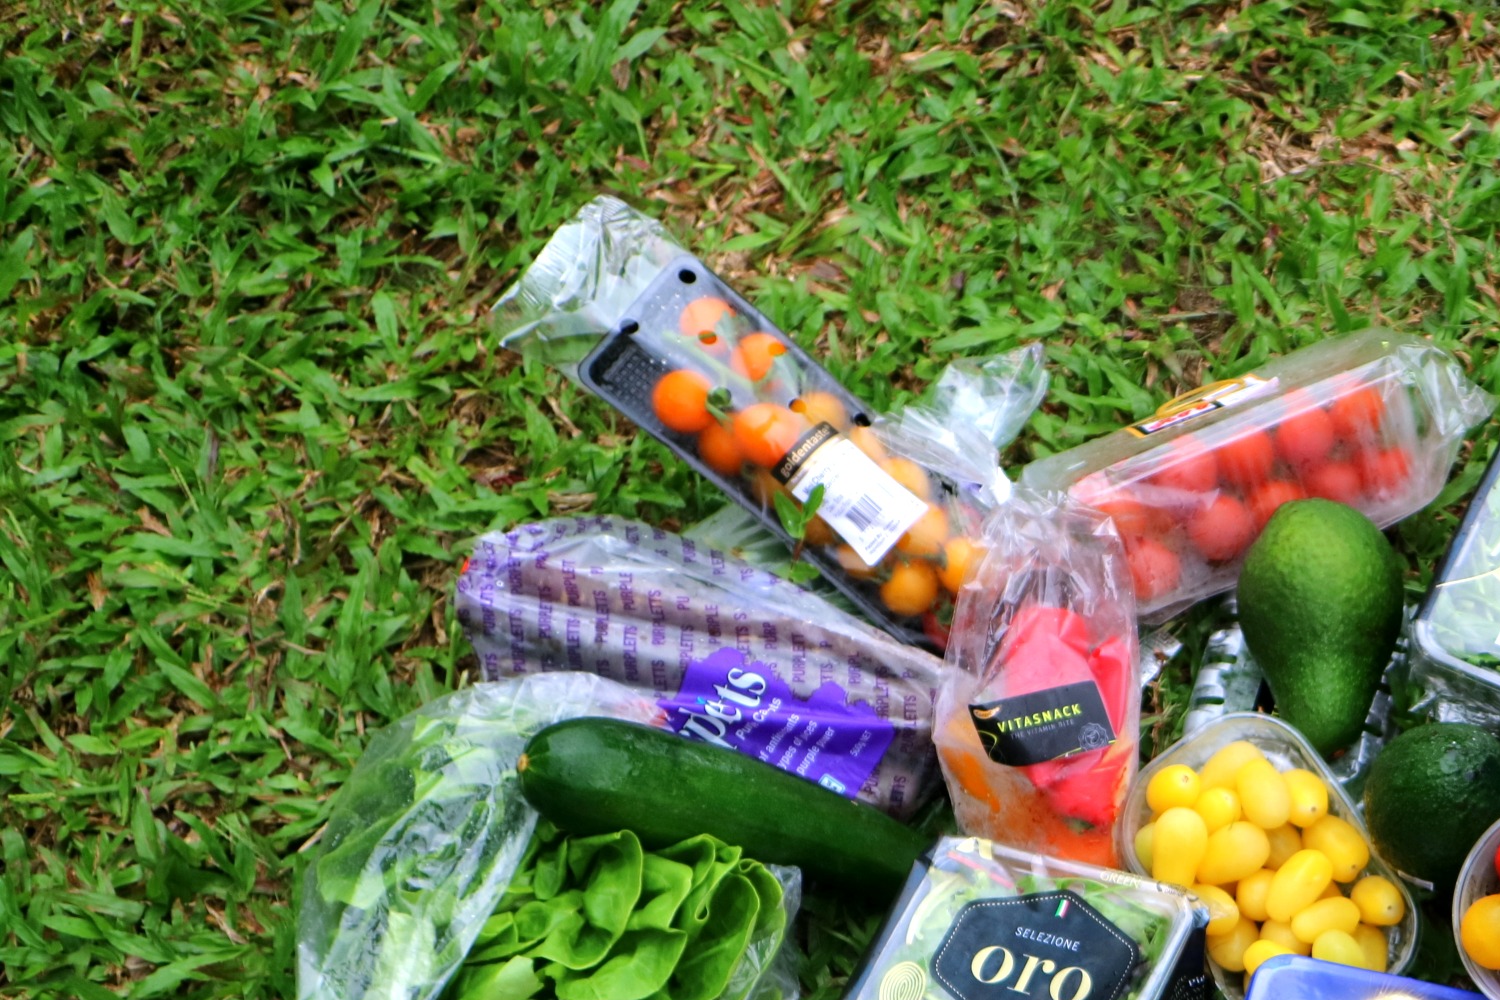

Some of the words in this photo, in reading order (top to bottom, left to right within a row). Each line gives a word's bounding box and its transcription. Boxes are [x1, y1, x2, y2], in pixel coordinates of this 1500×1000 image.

[780, 424, 830, 478] goldentaste
[997, 703, 1083, 733] VITASNACK
[1010, 731, 1025, 740] THE
[1027, 724, 1056, 736] VITAMIN
[1058, 718, 1076, 729] BITE
[776, 746, 798, 771] ypes
[796, 744, 820, 777] purple
[1100, 871, 1141, 889] GREEN
[1014, 925, 1081, 952] SELEZIONE
